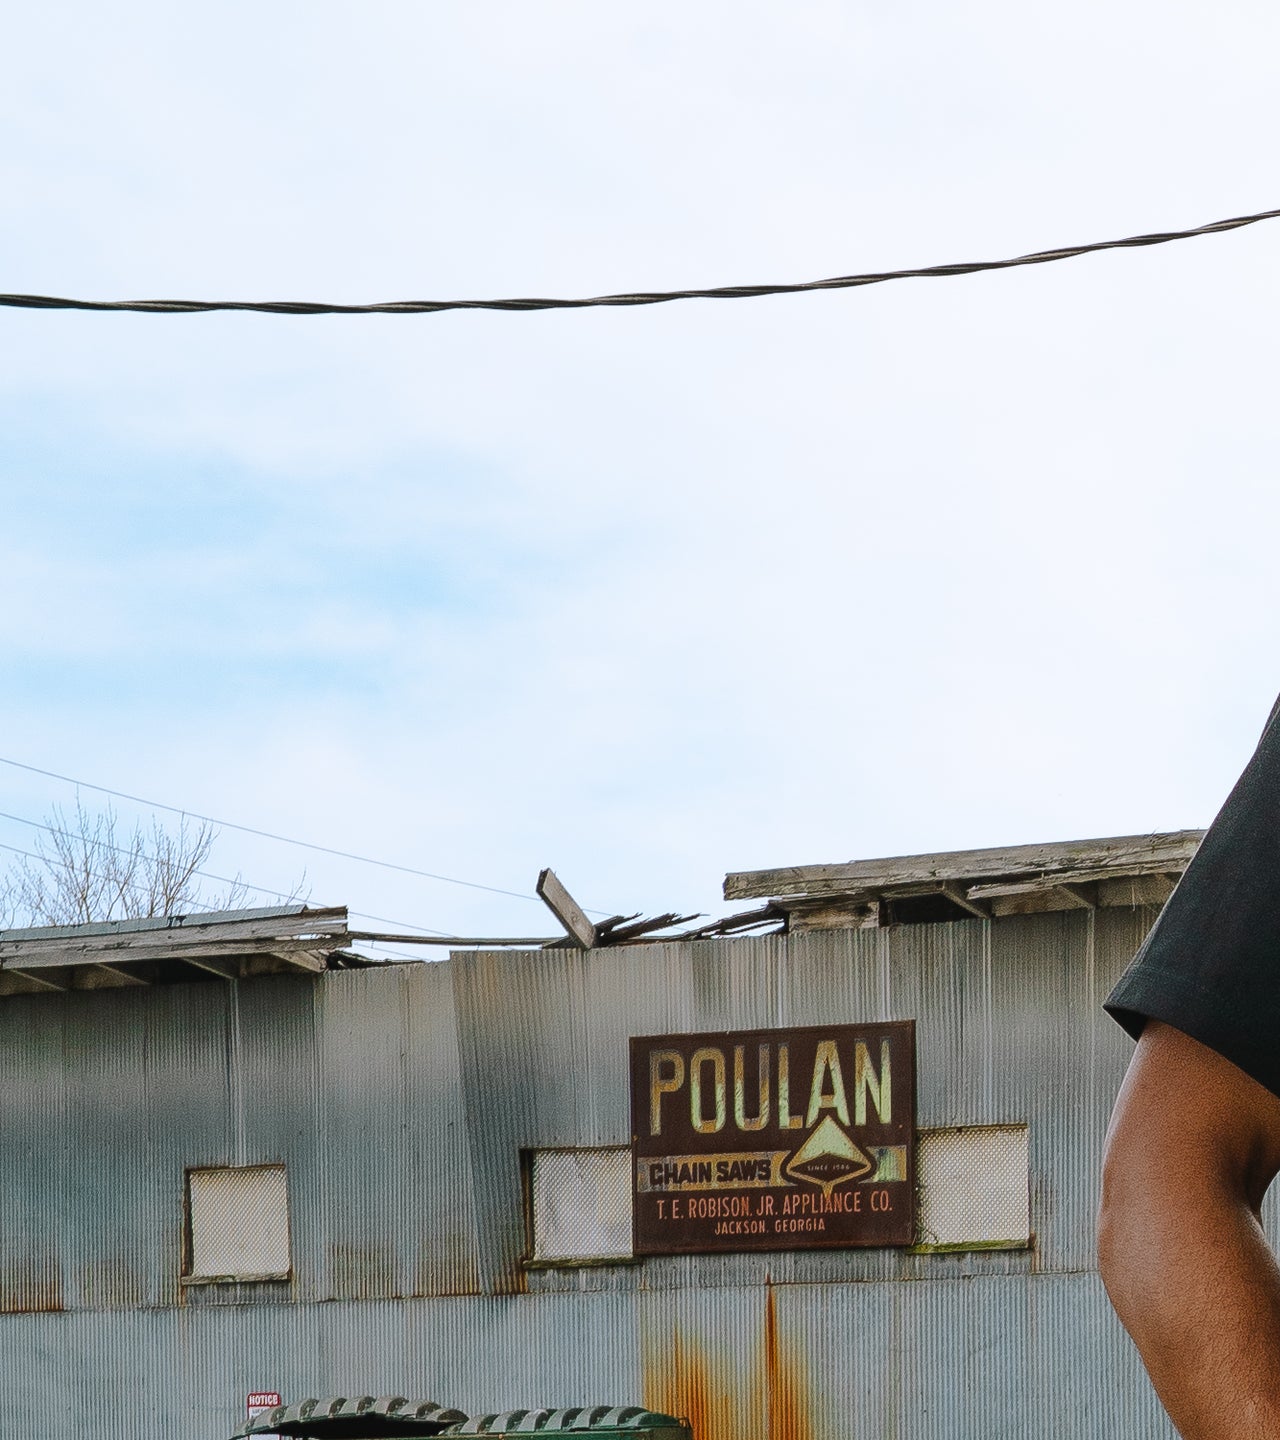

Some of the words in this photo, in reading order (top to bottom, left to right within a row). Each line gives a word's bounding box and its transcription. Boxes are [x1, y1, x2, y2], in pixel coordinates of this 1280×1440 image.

[650, 1039, 892, 1136] POULAN
[649, 1162, 712, 1186] CHAIN
[717, 1159, 772, 1182] SAWS
[657, 1199, 668, 1219] T.
[672, 1199, 684, 1219] E.
[756, 1195, 778, 1216] JR.
[782, 1191, 861, 1215] APPLIANCE
[870, 1190, 893, 1212] CO.
[774, 1218, 826, 1233] GEORGIA
[249, 1394, 278, 1405] NOTICE
